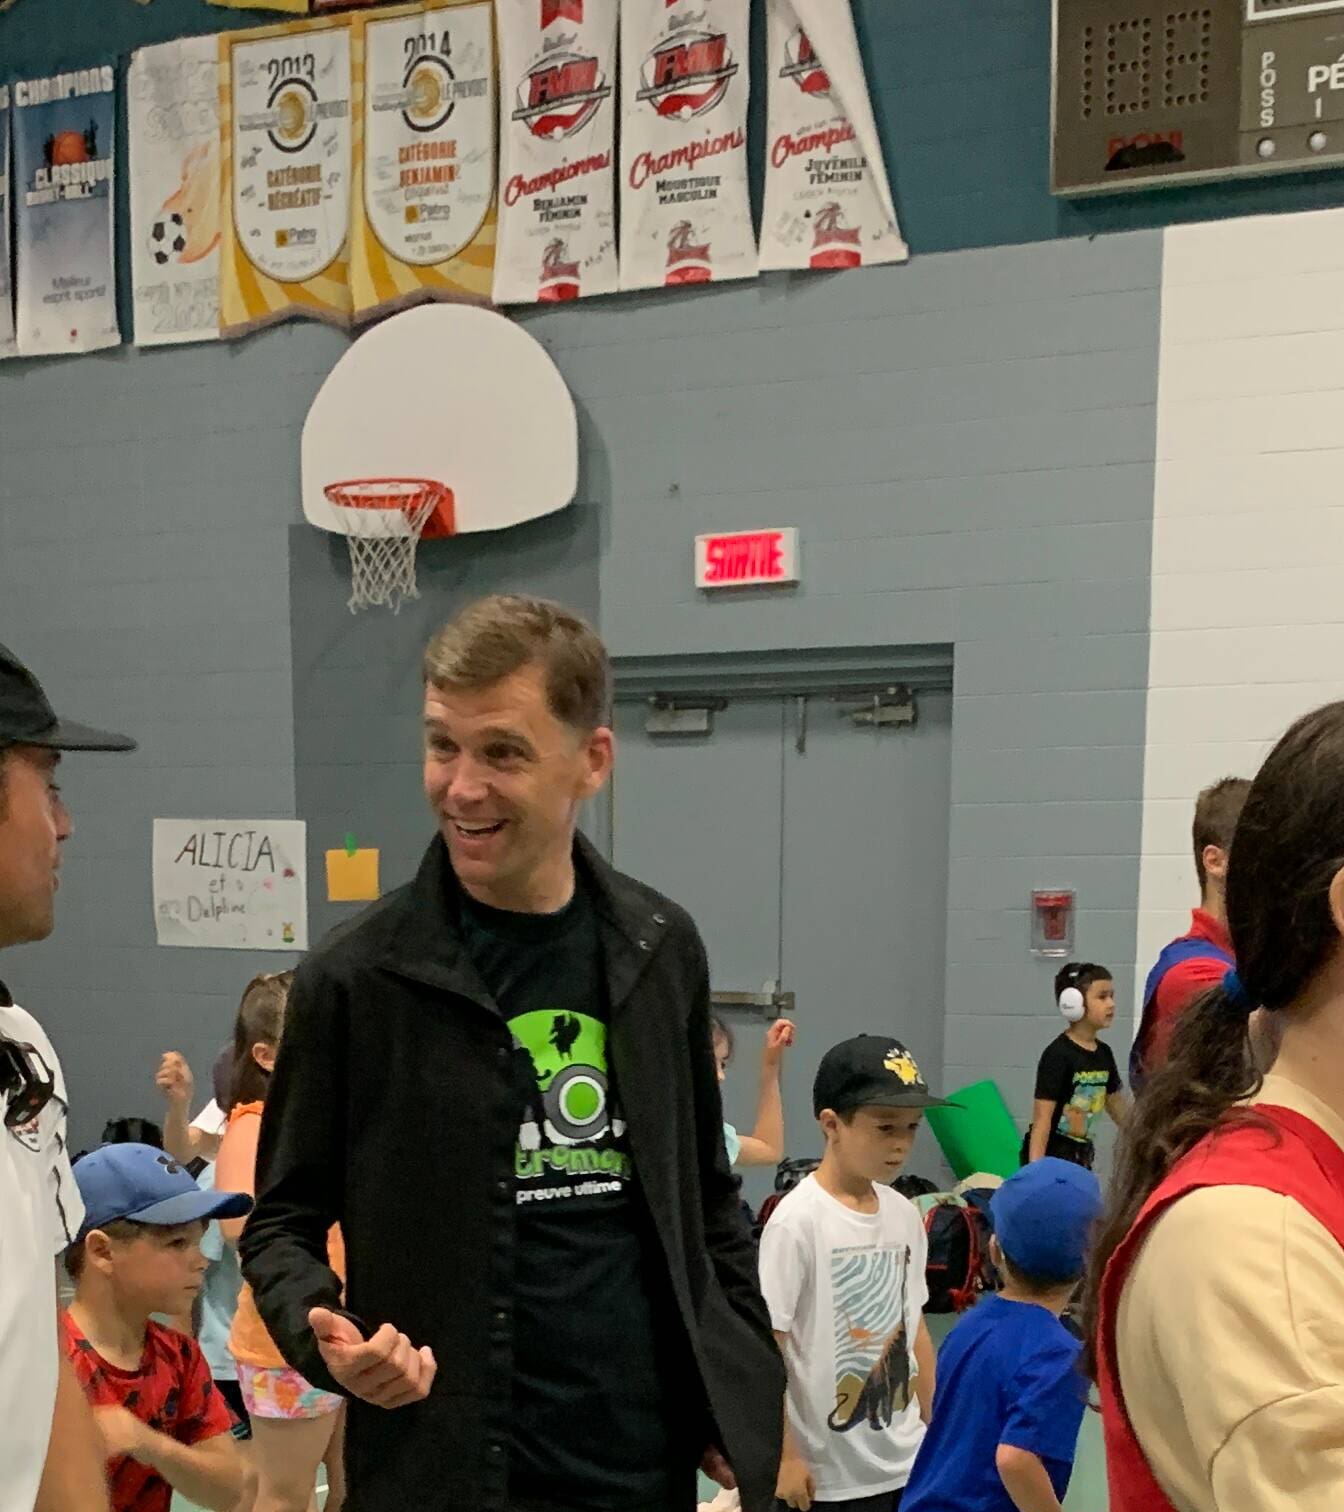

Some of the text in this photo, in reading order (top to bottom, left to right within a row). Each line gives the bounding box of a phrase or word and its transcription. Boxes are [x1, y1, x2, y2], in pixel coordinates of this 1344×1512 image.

[404, 30, 453, 63] 2014
[267, 54, 316, 89] 2013
[1260, 51, 1276, 127] POSS
[1314, 97, 1323, 119] 1
[629, 127, 745, 190] Champions
[655, 175, 722, 193] MOUSTIQUE
[533, 194, 588, 211] BENJAMIN
[658, 189, 718, 205] MASCULIN
[174, 830, 276, 874] ALICIA
[209, 873, 226, 894] et
[516, 1180, 623, 1205] preuve ultime
